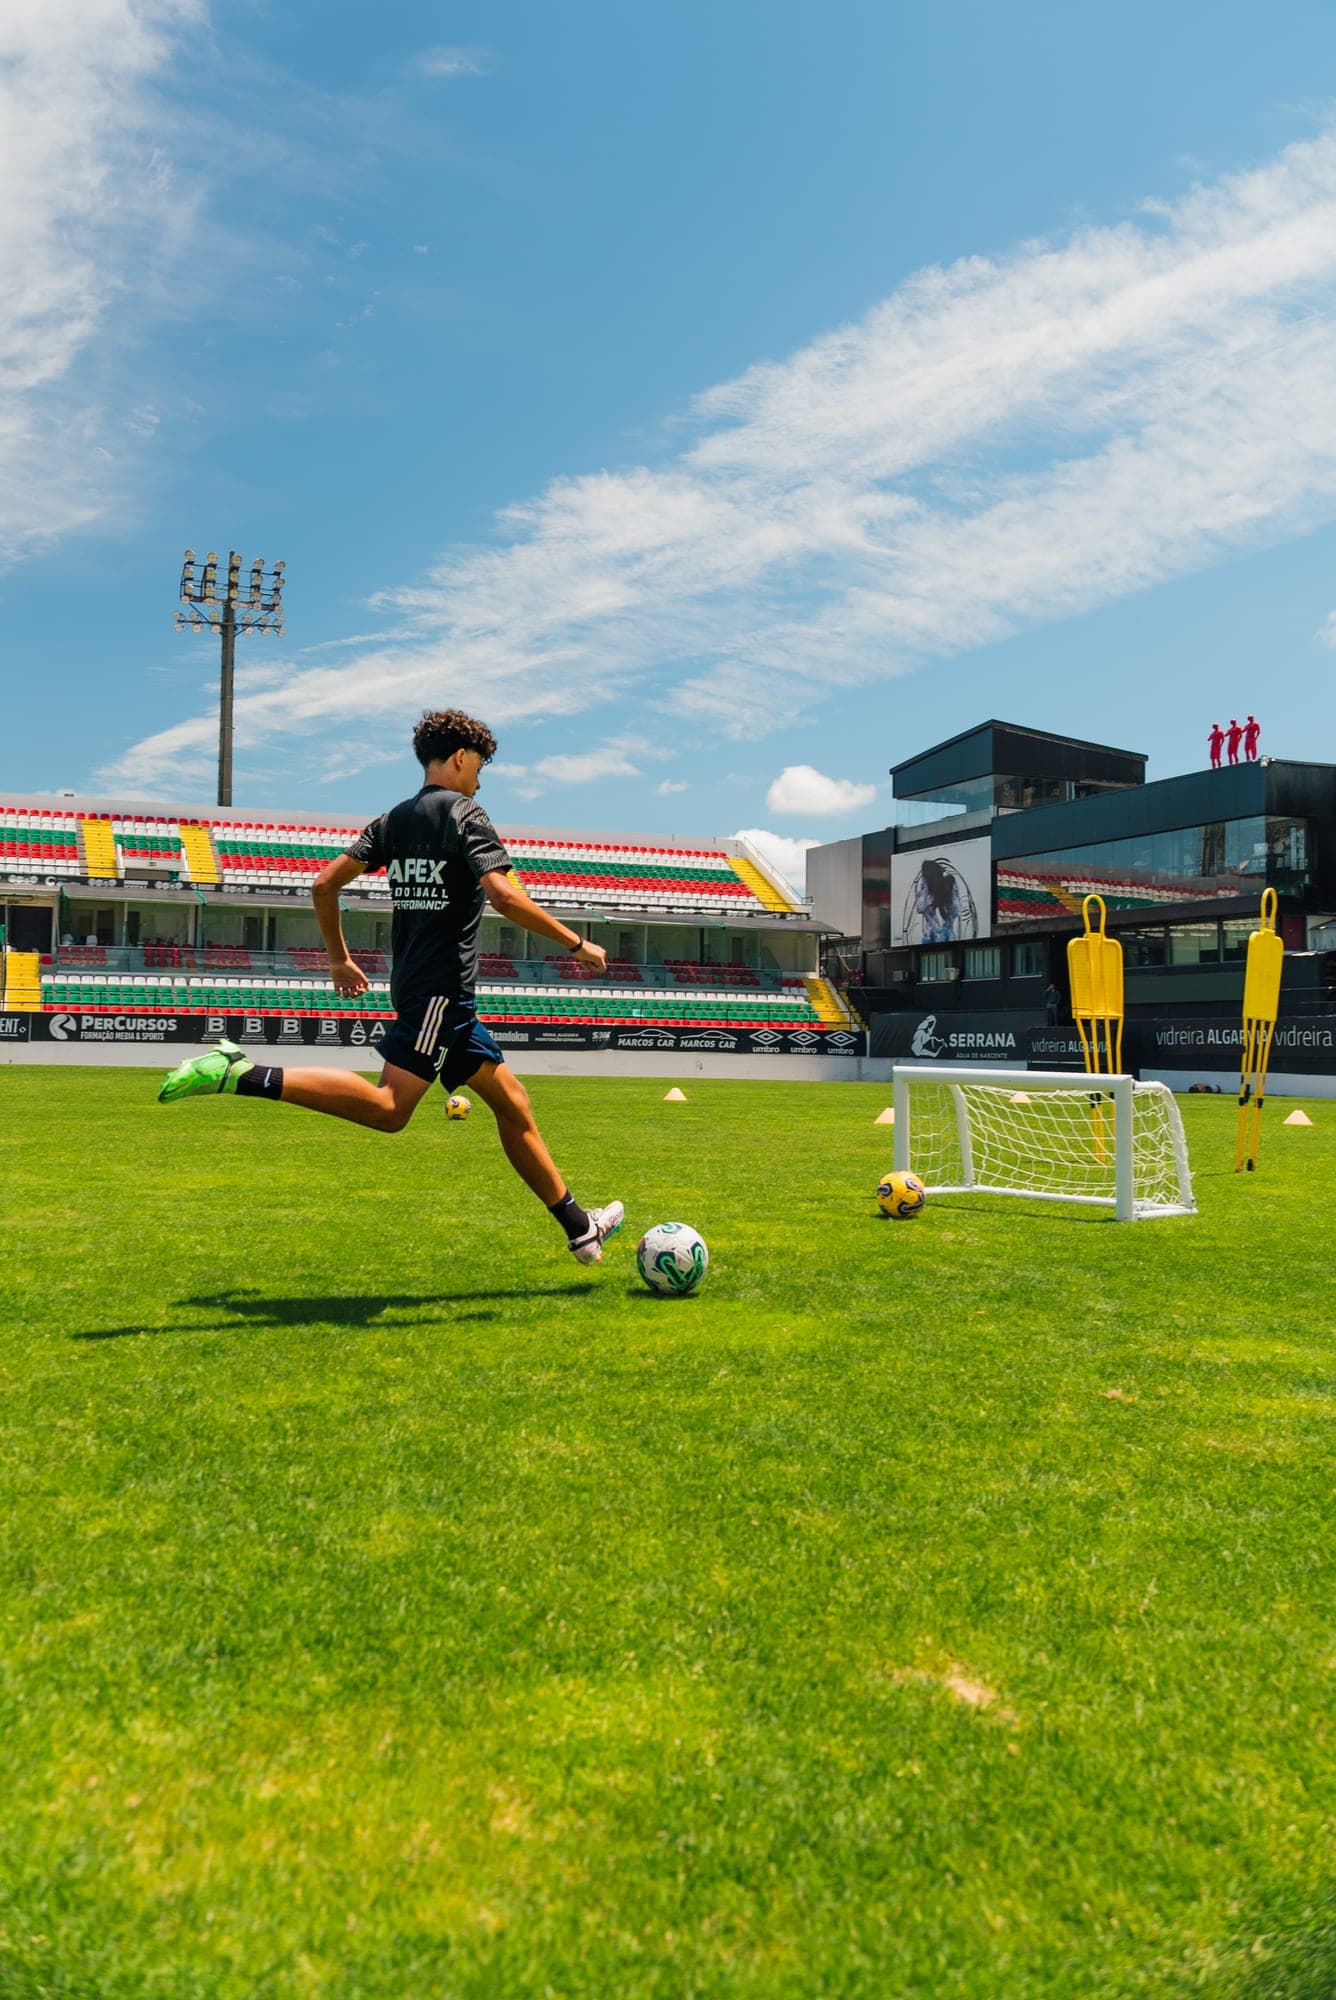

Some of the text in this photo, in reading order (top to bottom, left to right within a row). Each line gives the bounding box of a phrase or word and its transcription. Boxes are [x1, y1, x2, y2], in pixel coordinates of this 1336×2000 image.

[387, 857, 448, 885] APEX
[949, 1032, 1016, 1048] SERRANA
[1156, 1025, 1205, 1046] vidreira
[1274, 1025, 1333, 1047] vidreira
[618, 1038, 675, 1047] MARCOS CAR
[680, 1040, 736, 1049] MARCOS CAR
[1031, 1037, 1066, 1053] vidreira
[752, 1045, 780, 1053] umbro
[790, 1046, 817, 1054] umbro
[827, 1047, 855, 1055] umbro
